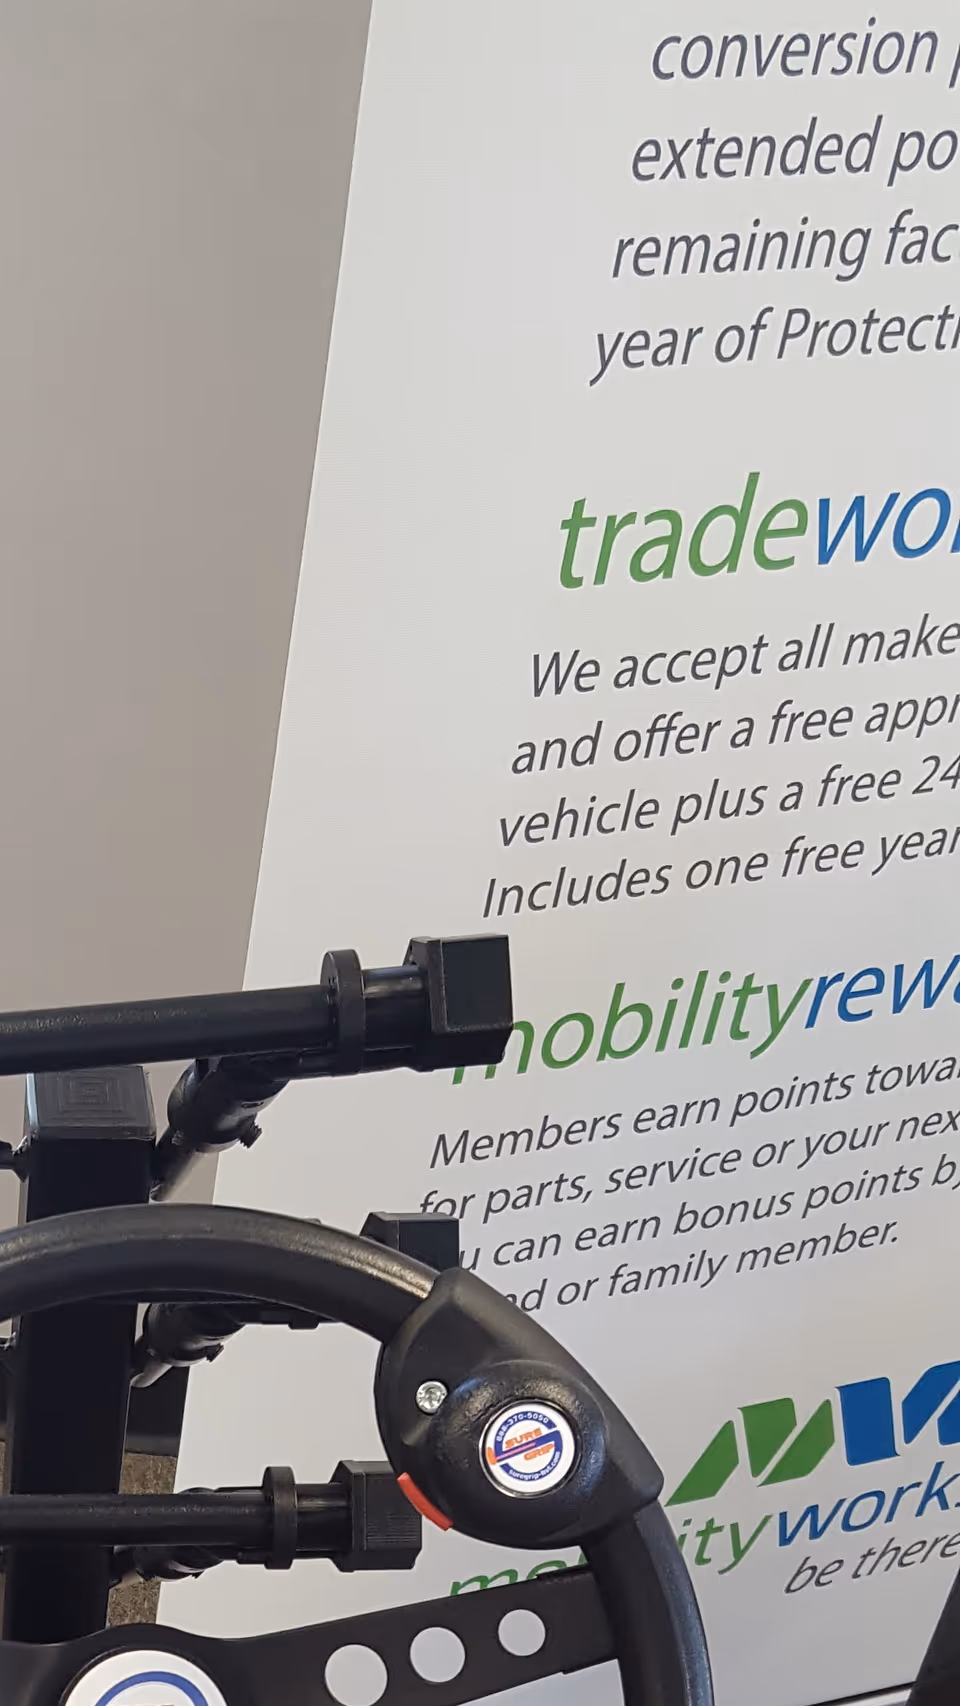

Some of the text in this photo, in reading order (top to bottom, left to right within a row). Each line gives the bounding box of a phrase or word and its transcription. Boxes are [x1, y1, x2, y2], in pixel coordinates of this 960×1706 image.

[651, 16, 939, 80] conversion
[632, 114, 960, 187] extended po
[612, 216, 872, 282] remaining
[589, 326, 703, 387] year
[714, 306, 774, 363] of
[531, 613, 960, 697] We accept all make
[511, 721, 603, 774] and
[613, 711, 721, 762] offer
[729, 715, 755, 749] a
[768, 700, 853, 744] free
[499, 789, 660, 847] vehicle
[671, 778, 766, 836] plus
[779, 780, 804, 813] a
[817, 764, 902, 808] free
[482, 858, 673, 918] Includes
[685, 850, 769, 890] one
[781, 836, 865, 878] free
[429, 1056, 960, 1169] Members earn points towa
[482, 1173, 593, 1224] parts,
[604, 1146, 743, 1197] service
[752, 1139, 796, 1169] or
[797, 1121, 889, 1169] your
[493, 1234, 562, 1266] can
[574, 1211, 661, 1252] earn
[673, 1188, 794, 1235] bonus
[801, 1164, 921, 1219] points
[931, 1153, 960, 1190] b
[557, 1276, 601, 1307] or
[608, 1250, 728, 1300] family
[736, 1219, 898, 1274] member.
[505, 1427, 542, 1449] SURE
[523, 1443, 554, 1461] GRIP
[784, 1533, 960, 1594] be there
